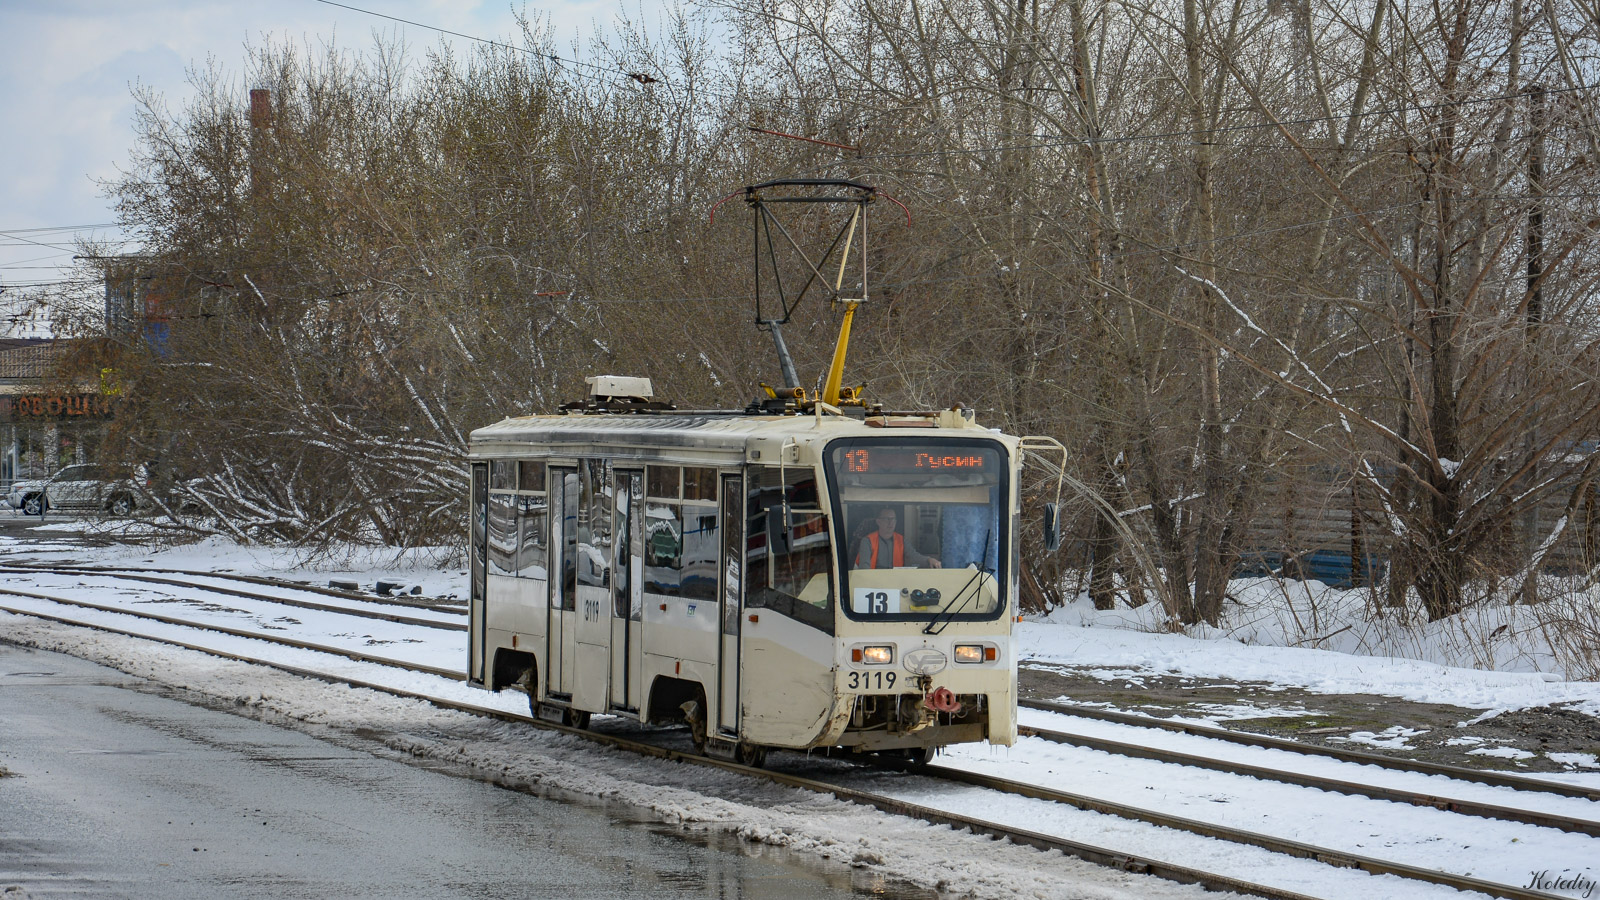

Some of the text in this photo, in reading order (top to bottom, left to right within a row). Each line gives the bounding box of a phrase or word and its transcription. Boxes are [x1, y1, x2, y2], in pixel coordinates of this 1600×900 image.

[846, 450, 868, 472] 13
[916, 453, 983, 468] Гусин
[585, 600, 600, 622] 3119
[865, 592, 889, 613] 13
[848, 672, 897, 689] 3119
